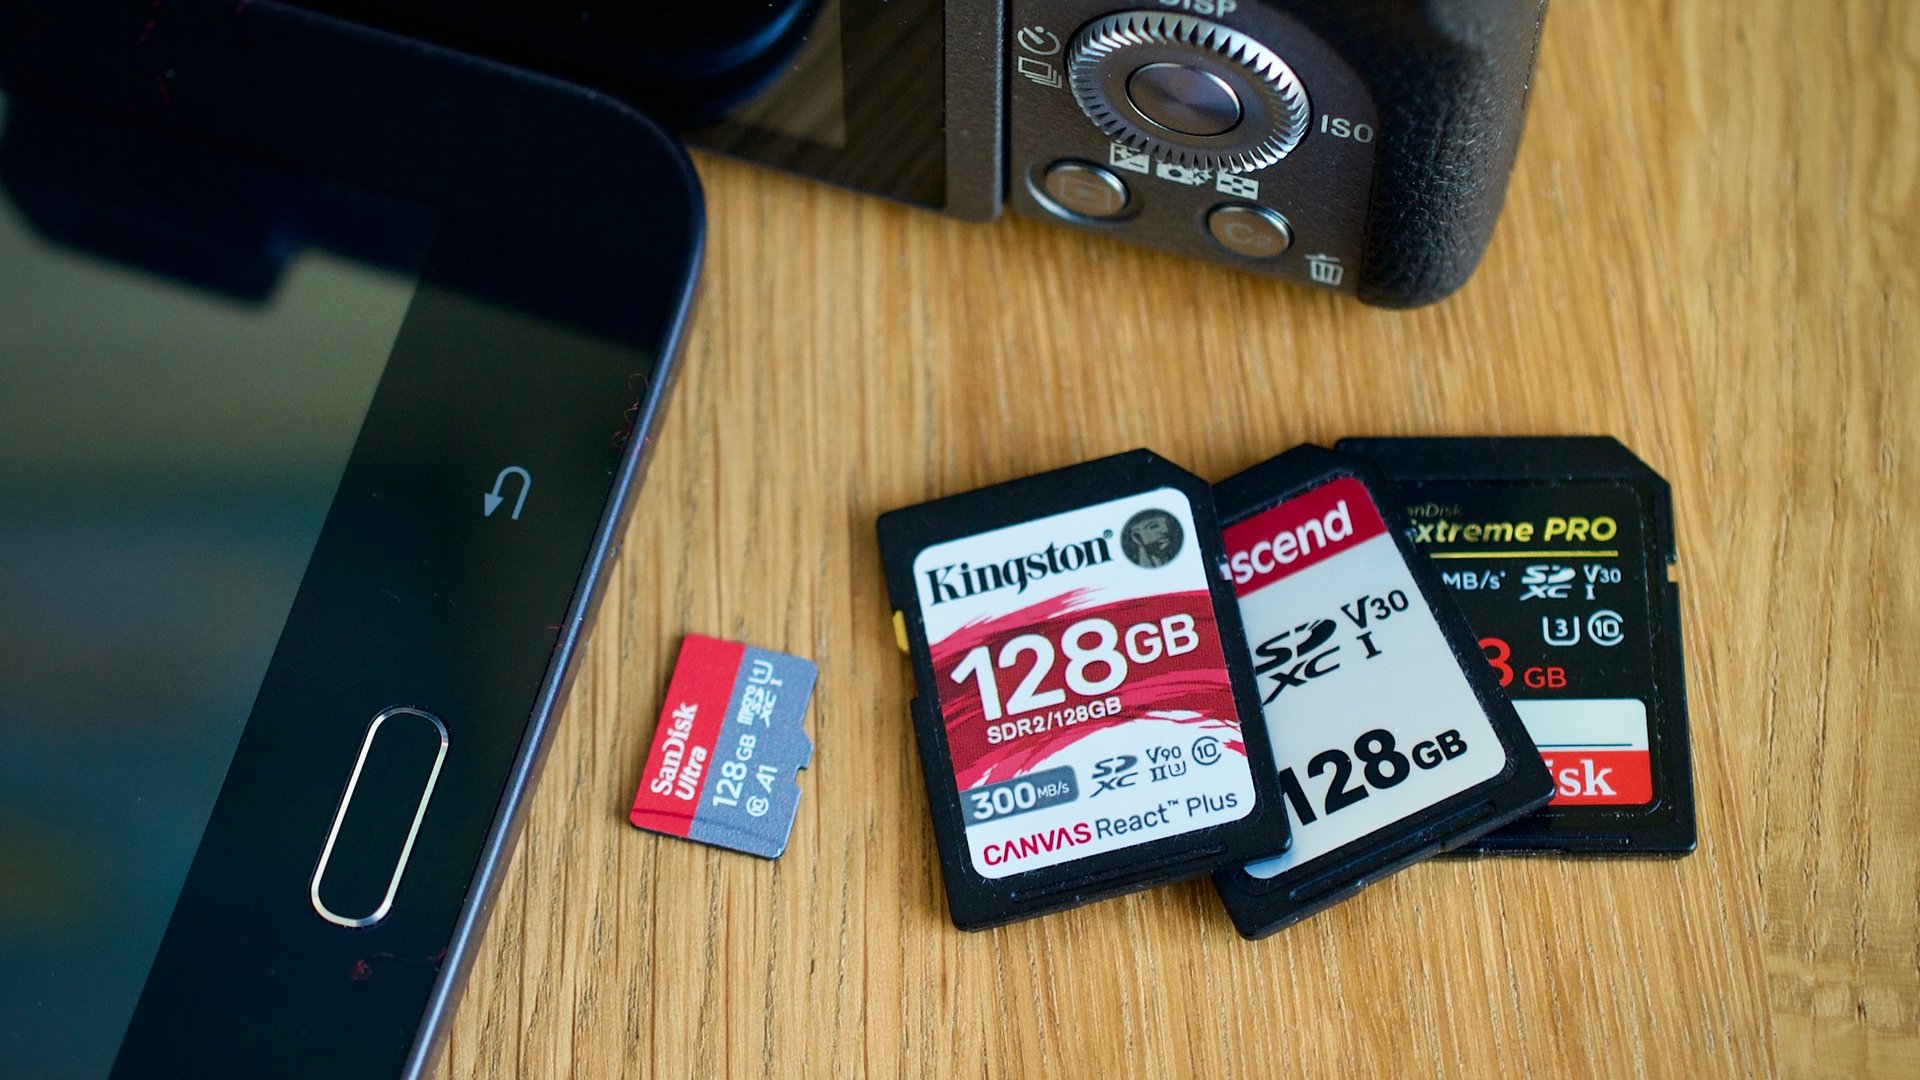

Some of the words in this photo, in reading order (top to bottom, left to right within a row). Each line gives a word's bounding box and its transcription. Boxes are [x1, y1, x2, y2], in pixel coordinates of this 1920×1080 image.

[1320, 114, 1374, 143] ISO
[1410, 518, 1535, 544] xtreme
[1543, 515, 1618, 542] PRO
[1583, 564, 1623, 584] V30
[1341, 589, 1410, 630] V30
[1523, 666, 1568, 688] GB
[986, 696, 1122, 745] SDR2/128GB
[650, 701, 698, 796] SanDisk
[1145, 745, 1182, 765] V90
[675, 745, 708, 801] Ultra
[755, 764, 779, 794] A1
[983, 822, 1092, 866] CANVAS
[1186, 791, 1239, 818] Plus
